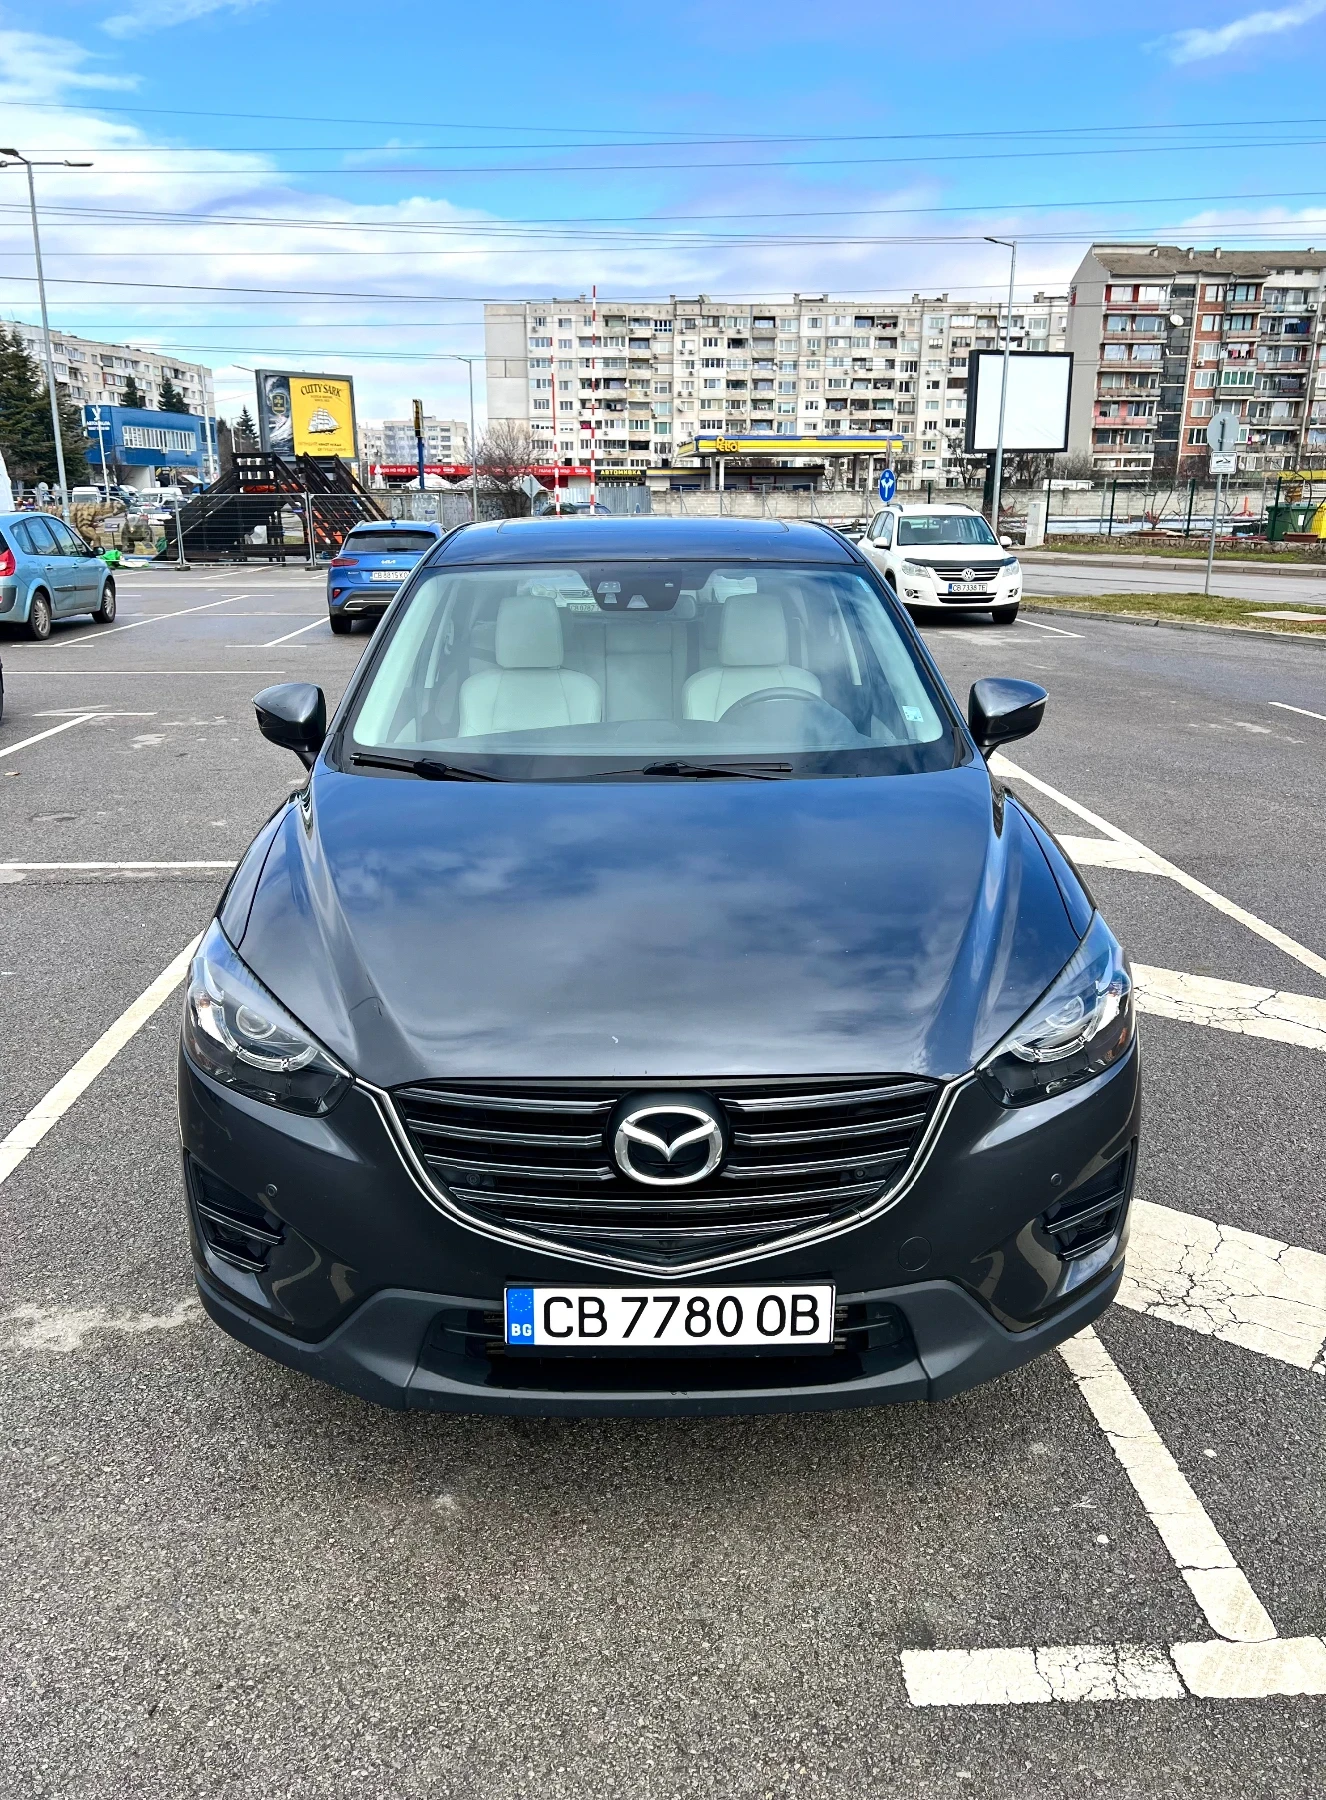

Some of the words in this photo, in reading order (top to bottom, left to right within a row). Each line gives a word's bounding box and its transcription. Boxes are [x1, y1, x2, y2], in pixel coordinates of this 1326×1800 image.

[300, 383, 322, 395] CUTTY
[322, 384, 342, 398] SARK
[543, 1296, 608, 1338] CB
[621, 1295, 744, 1339] 7780
[756, 1294, 820, 1337] OB
[511, 1323, 532, 1337] BG
